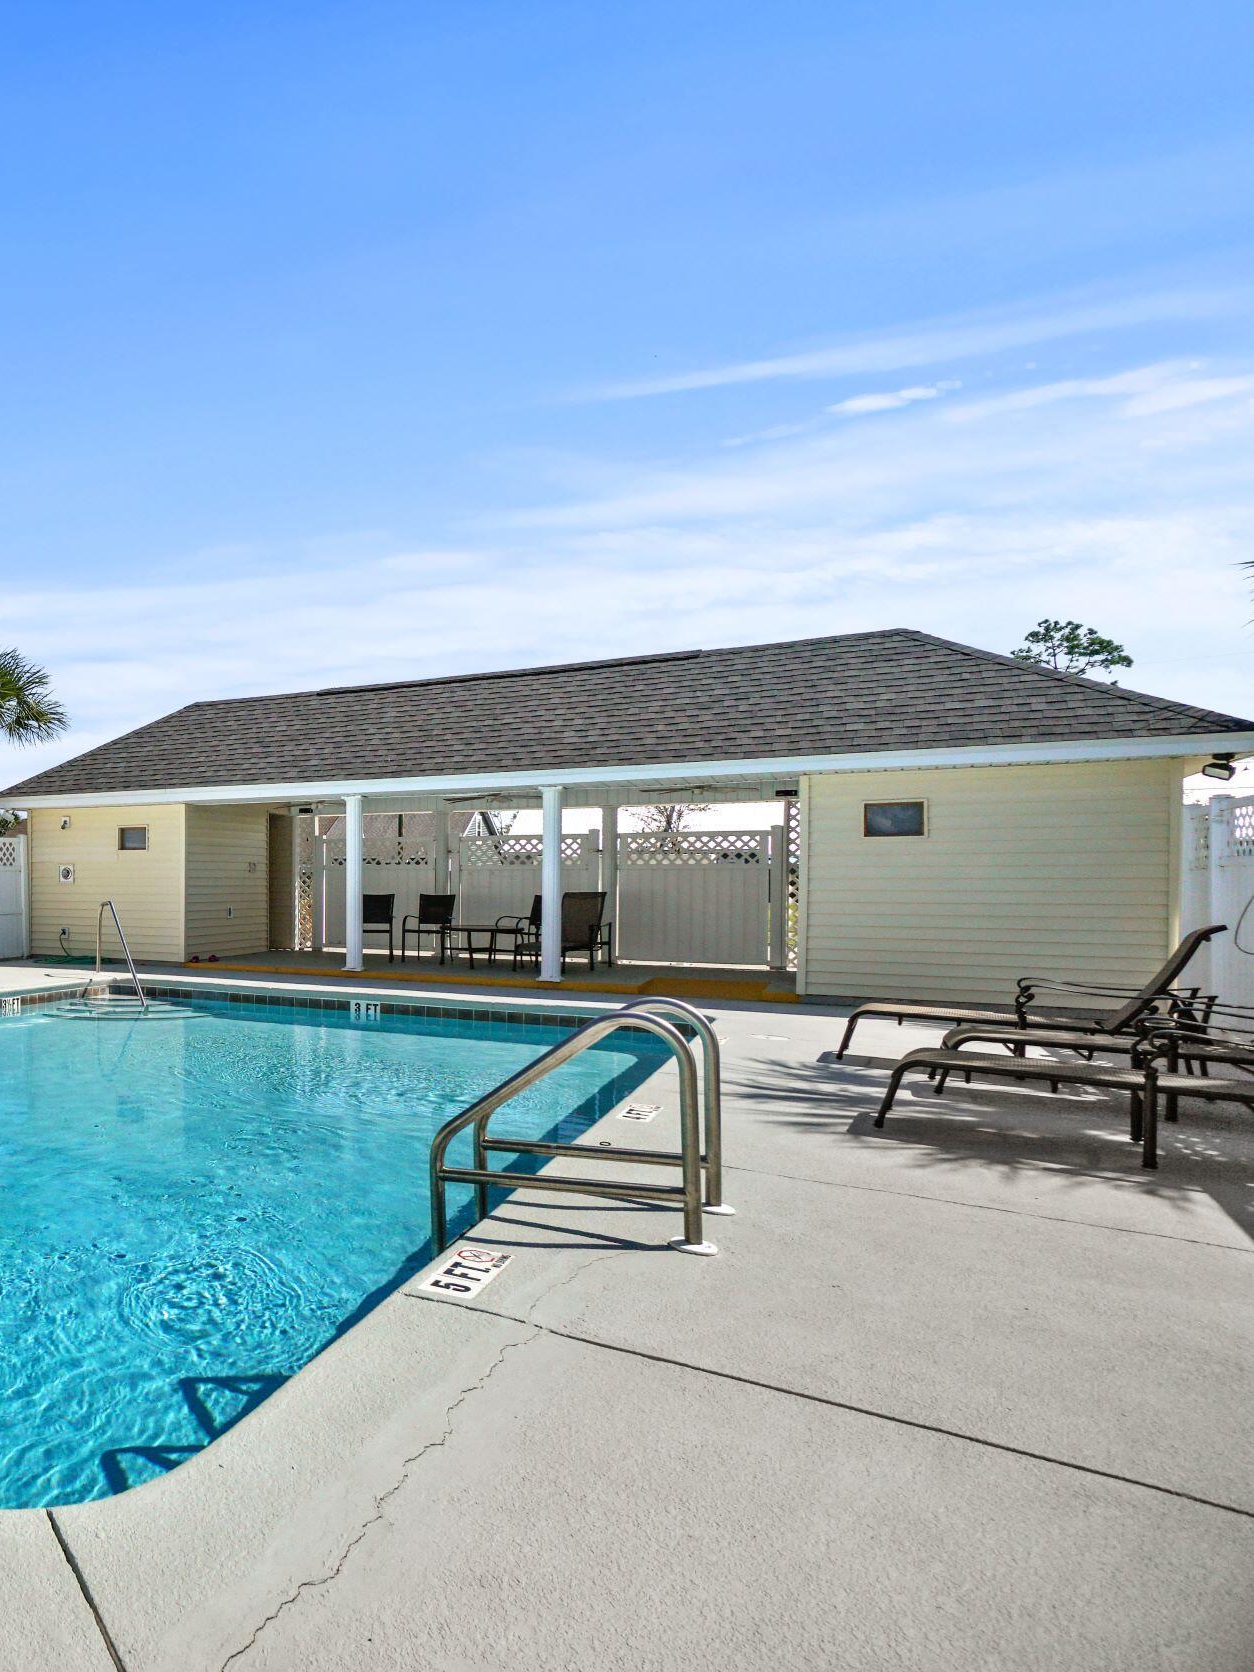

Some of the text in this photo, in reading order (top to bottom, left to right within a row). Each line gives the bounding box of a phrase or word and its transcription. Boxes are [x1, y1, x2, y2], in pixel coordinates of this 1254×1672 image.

[354, 1002, 379, 1013] 3 FT
[430, 1279, 472, 1293] 5
